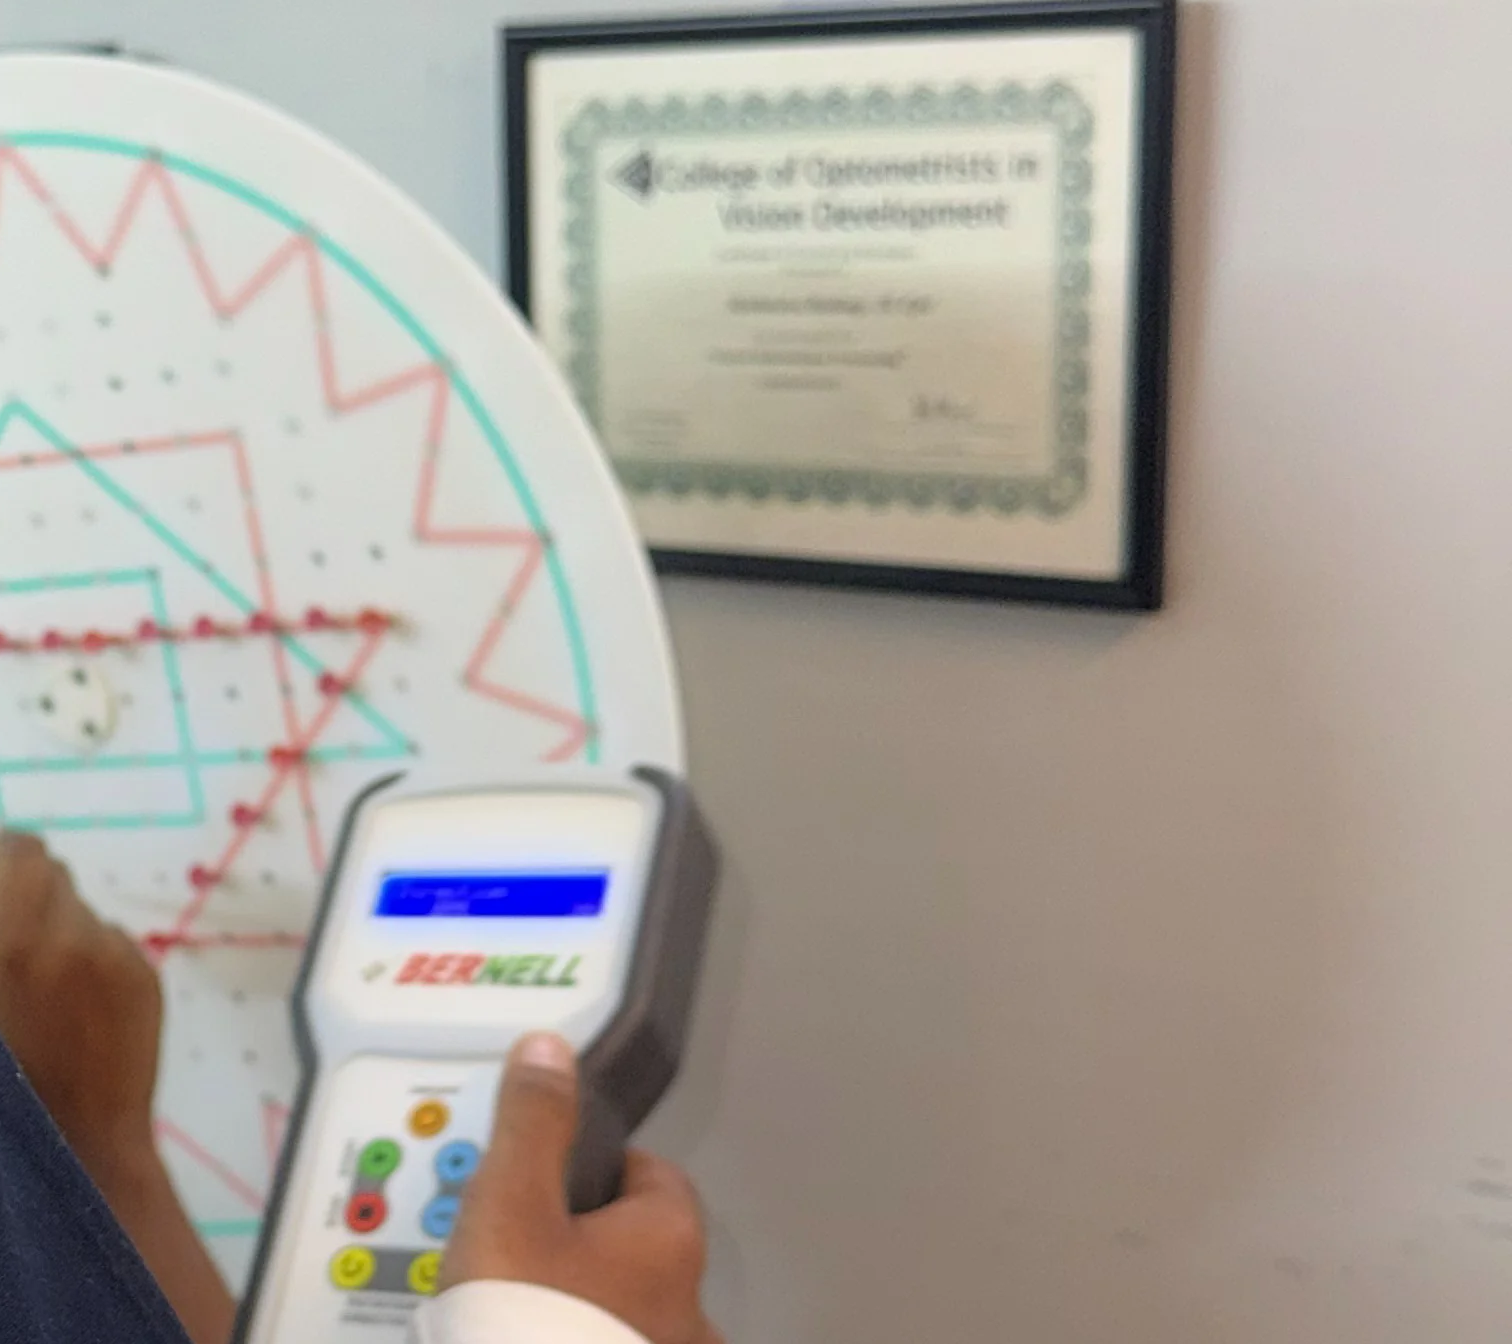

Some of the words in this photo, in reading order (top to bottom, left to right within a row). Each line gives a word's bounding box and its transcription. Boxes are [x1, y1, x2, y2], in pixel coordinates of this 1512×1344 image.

[656, 155, 758, 194] College
[765, 153, 794, 188] of
[716, 199, 803, 232] Vision
[812, 196, 1010, 235] Development
[394, 952, 582, 987] BERNELL
